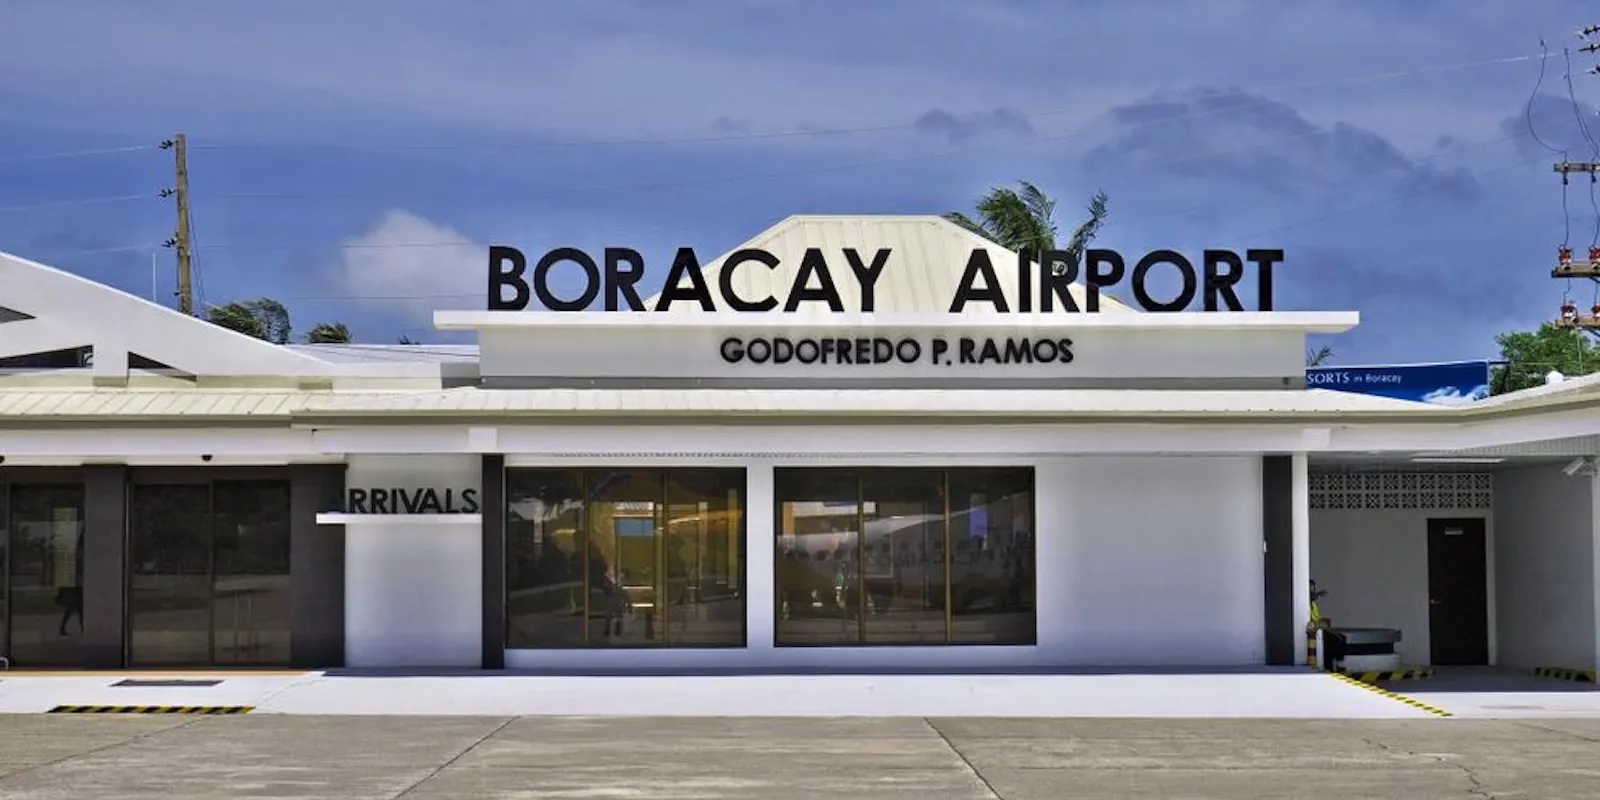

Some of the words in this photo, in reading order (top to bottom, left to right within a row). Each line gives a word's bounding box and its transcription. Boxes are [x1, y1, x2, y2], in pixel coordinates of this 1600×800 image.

[487, 245, 892, 312] BORACAY
[949, 248, 1284, 312] AIRPORT
[719, 337, 922, 365] GODOFREDO
[931, 338, 953, 367] P.
[959, 338, 1074, 365] RAMOS
[324, 487, 479, 514] RRIVALS
